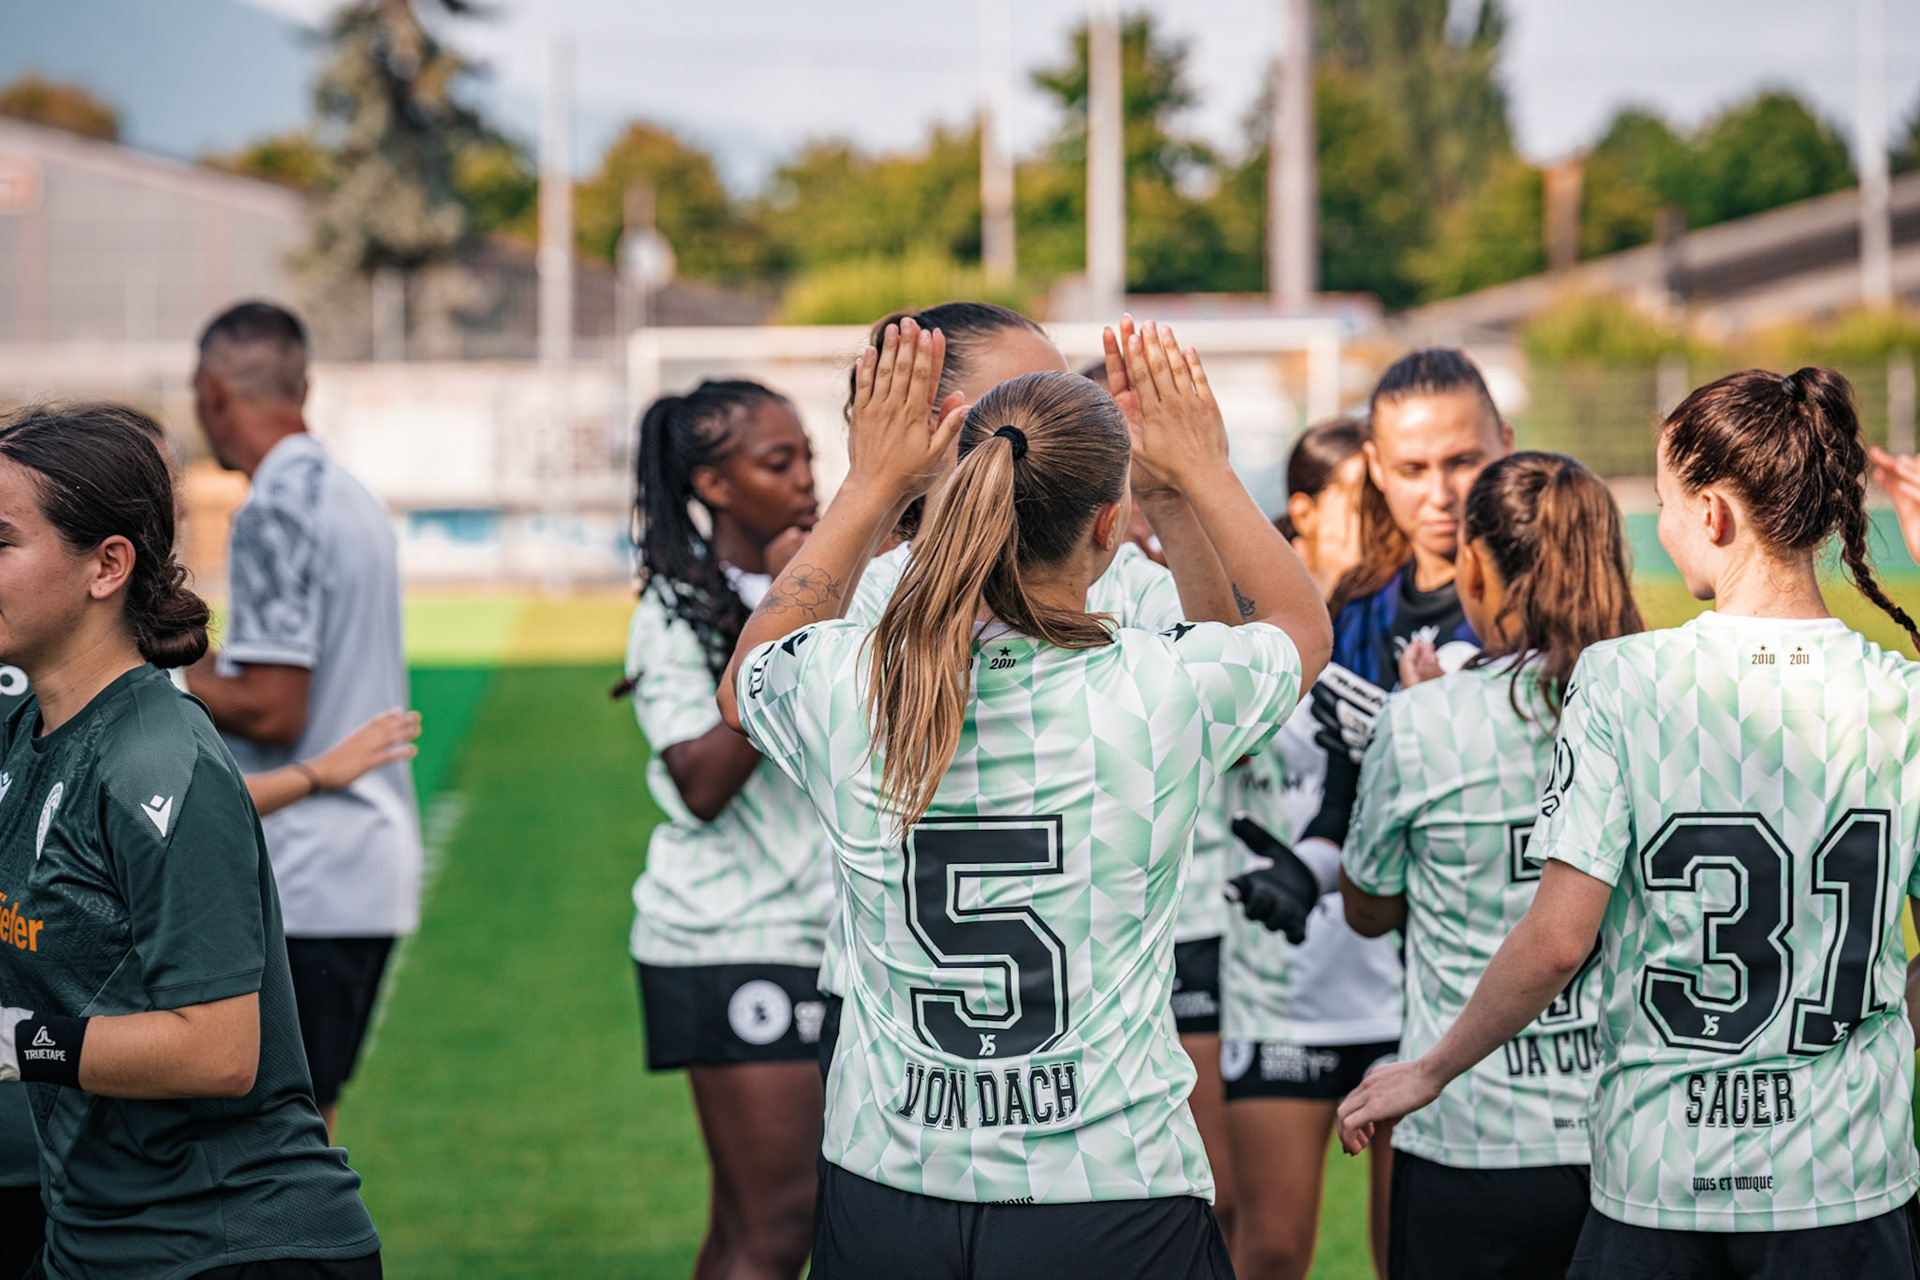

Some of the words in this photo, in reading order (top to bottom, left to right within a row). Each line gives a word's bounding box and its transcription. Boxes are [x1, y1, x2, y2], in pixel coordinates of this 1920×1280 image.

[989, 657, 1016, 670] 2011
[1751, 653, 1775, 665] 2010
[1789, 653, 1810, 665] 2011
[903, 814, 1069, 1059] 5
[1640, 808, 1891, 1056] 31
[23, 1048, 67, 1062] TRUETAPE
[896, 1062, 968, 1130] VON
[974, 1062, 1077, 1127] DACH
[1686, 1070, 1797, 1128] SAGER
[1719, 1177, 1732, 1191] ET
